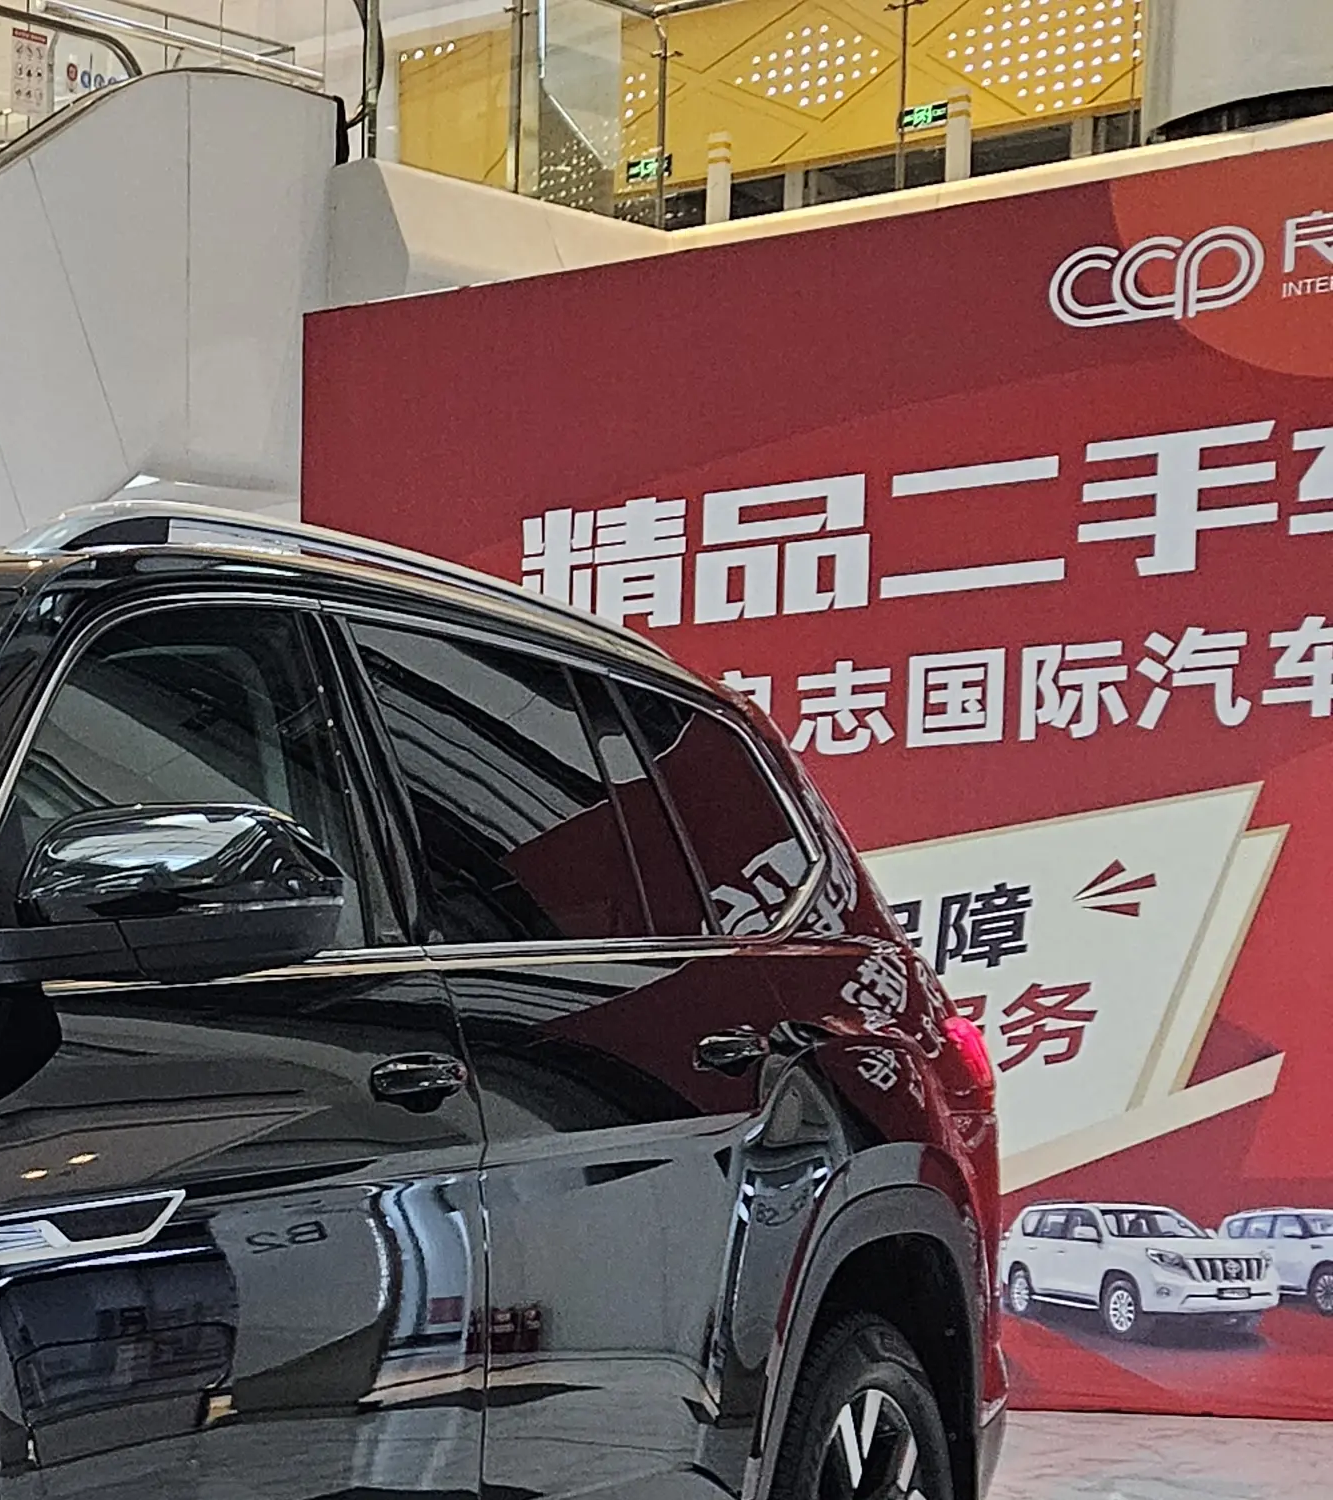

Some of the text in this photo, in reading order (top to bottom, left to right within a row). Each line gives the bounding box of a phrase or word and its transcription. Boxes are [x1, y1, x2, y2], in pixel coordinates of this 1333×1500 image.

[1281, 275, 1333, 299] INTE
[521, 420, 1333, 630] 精品二手
